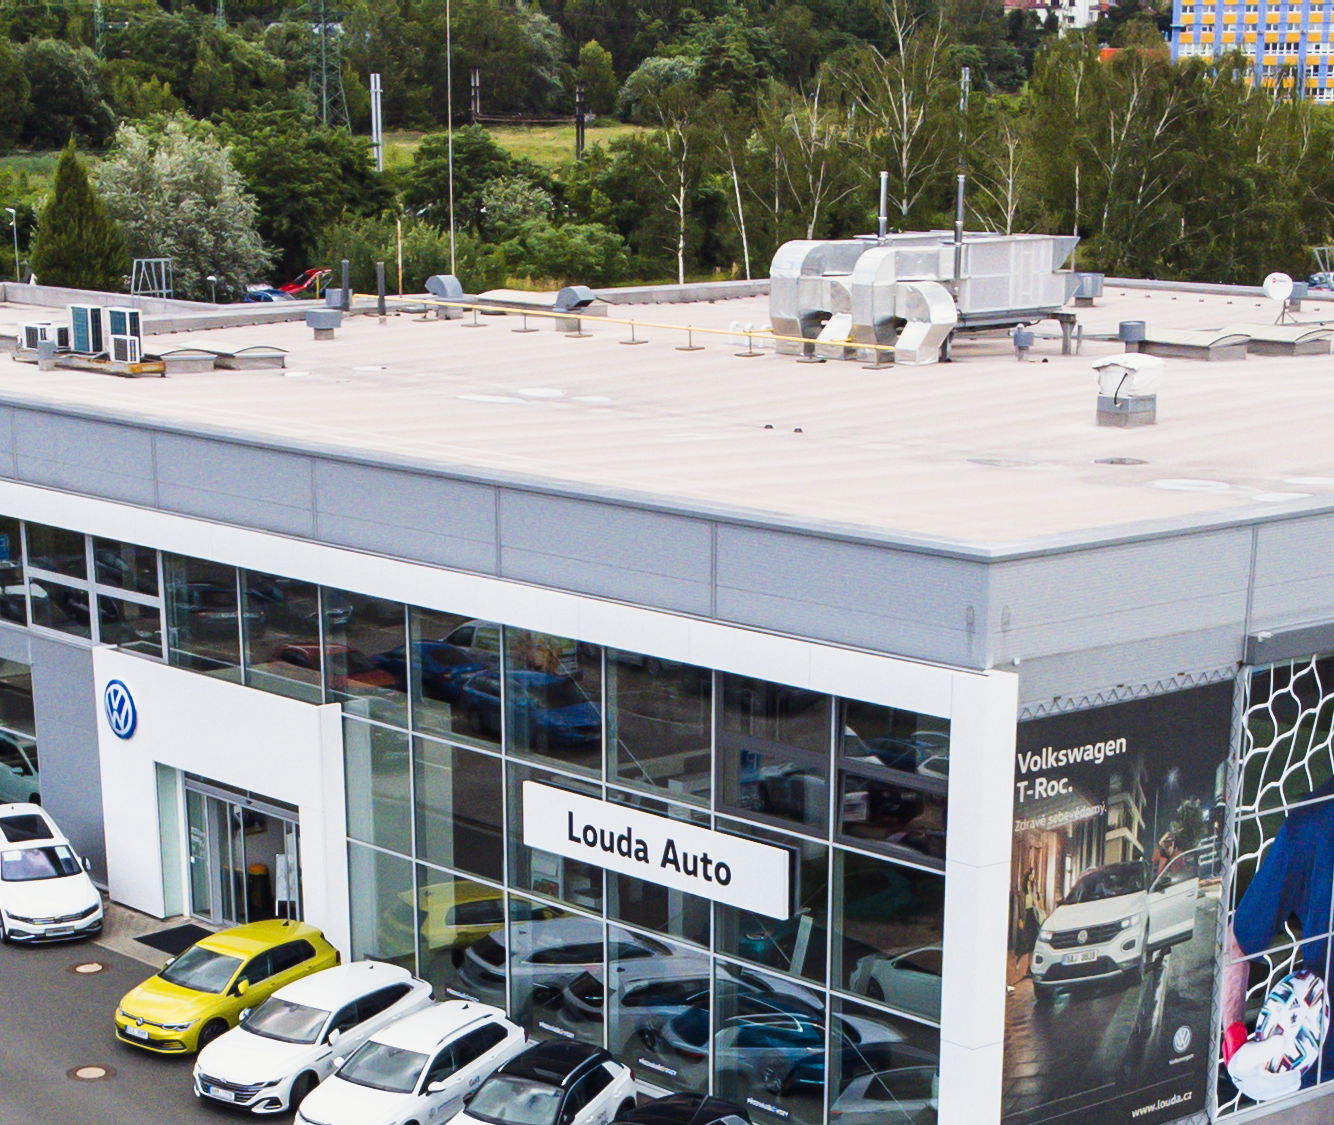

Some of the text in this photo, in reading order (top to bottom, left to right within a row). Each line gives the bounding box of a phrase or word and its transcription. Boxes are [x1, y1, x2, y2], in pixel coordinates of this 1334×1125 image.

[1018, 737, 1127, 774] Volkswagen
[1017, 777, 1073, 803] T-Roc.
[568, 810, 732, 886] Louda Auto
[1131, 1091, 1194, 1118] www.louda.cz
